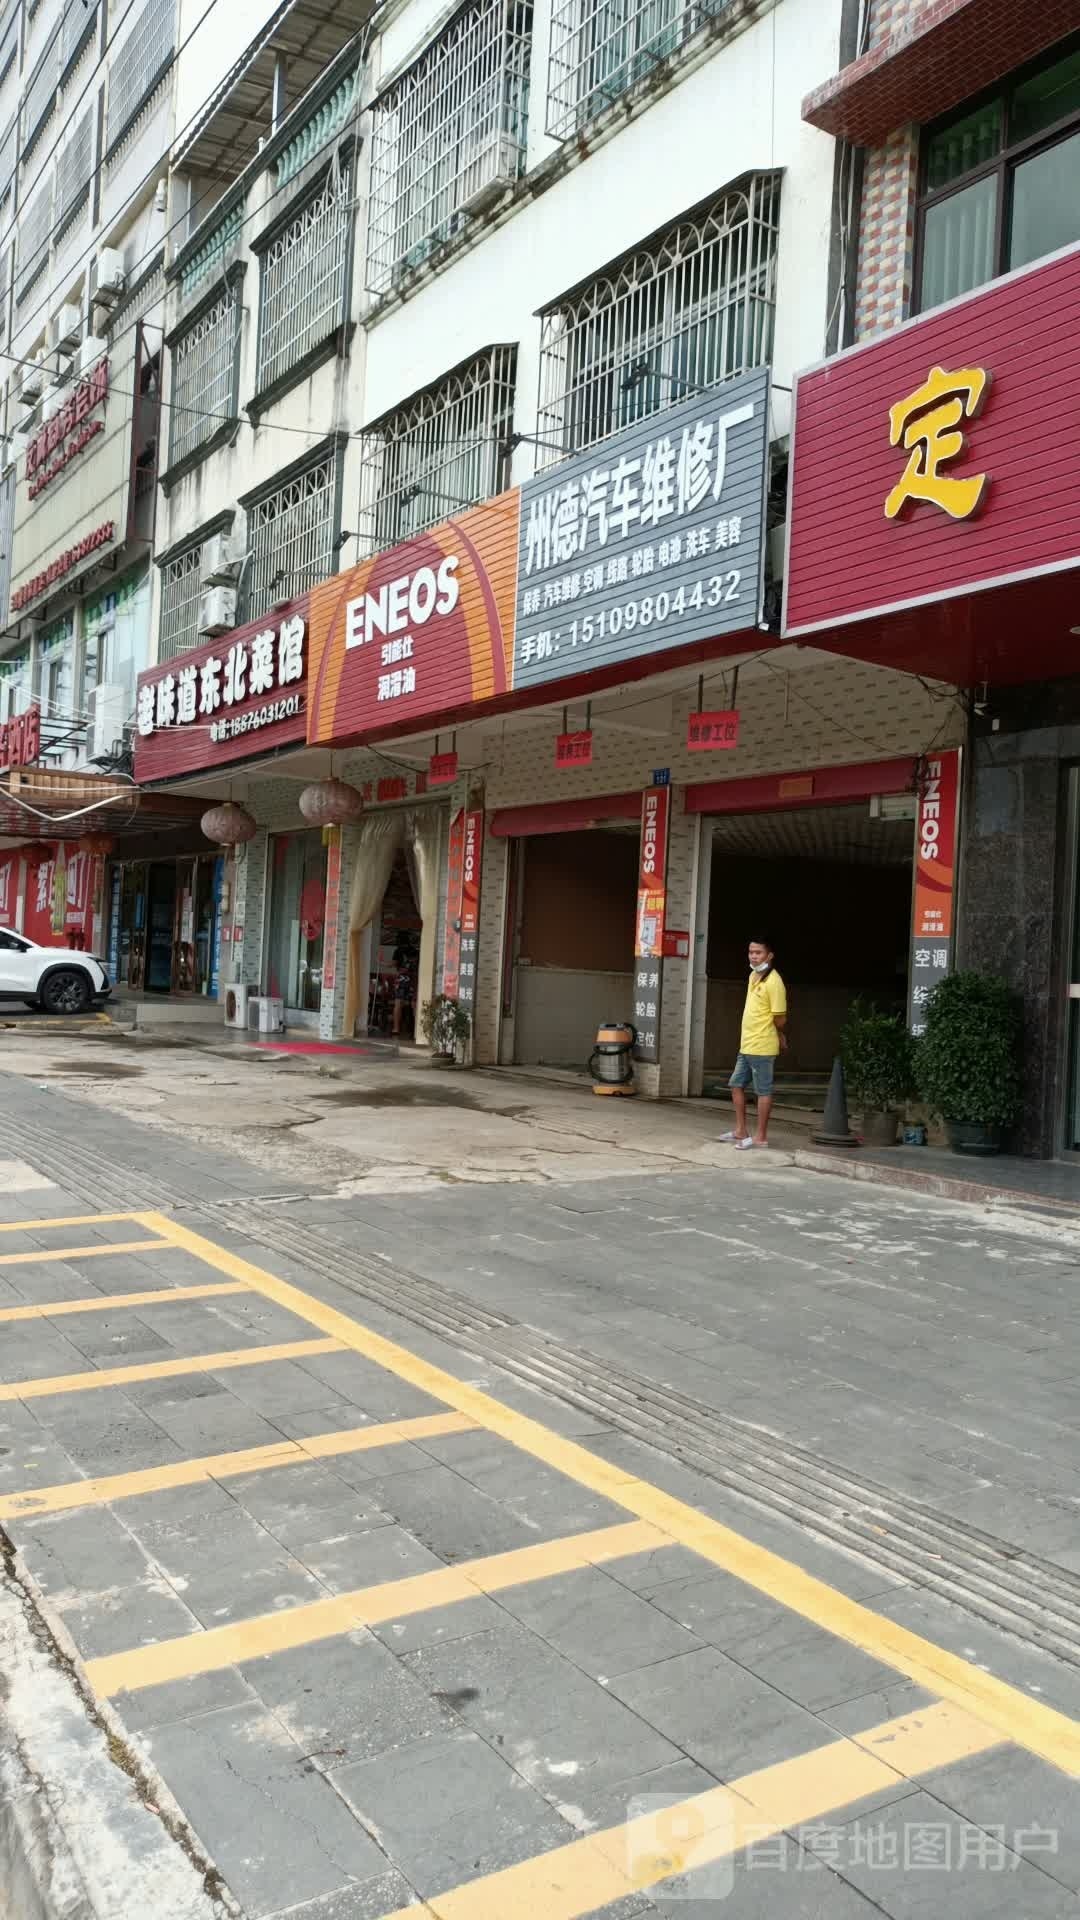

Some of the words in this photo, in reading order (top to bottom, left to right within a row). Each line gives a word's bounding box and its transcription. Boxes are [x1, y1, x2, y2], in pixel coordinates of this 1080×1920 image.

[885, 367, 986, 518] 定
[525, 403, 754, 576] 州德汽车维修厂
[523, 588, 541, 616] 保养
[544, 573, 580, 607] 汽车维修
[583, 564, 604, 594] 空调
[632, 545, 655, 576] 轮胎
[659, 535, 682, 567] 电池
[686, 527, 711, 558] 洗车
[715, 516, 742, 550] 美容
[345, 555, 460, 650] ENEOS
[377, 666, 416, 701] 润滑油
[381, 635, 414, 666] 引能仕
[643, 796, 658, 873] ENEOS
[920, 760, 941, 861] ENEOS
[464, 818, 476, 881] ENEOS
[637, 972, 658, 988] 保养
[915, 949, 947, 968] 空调
[635, 1001, 656, 1018] 轮胎
